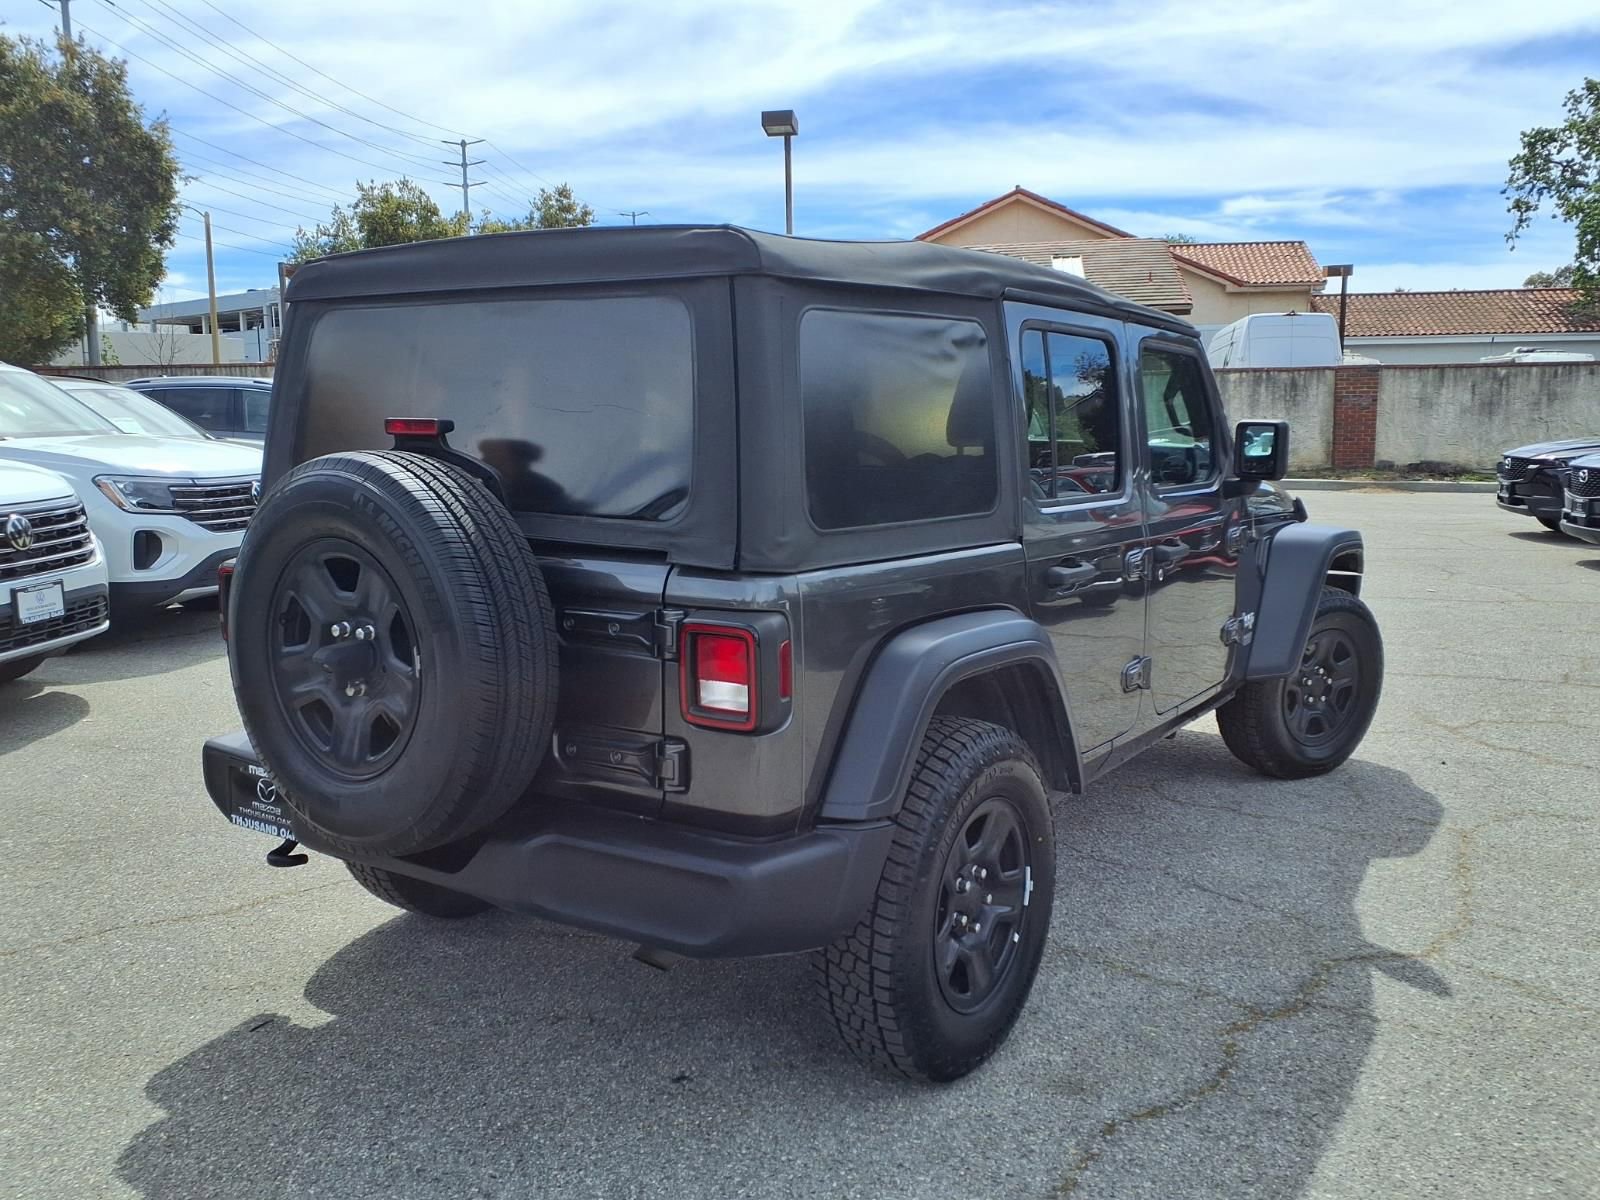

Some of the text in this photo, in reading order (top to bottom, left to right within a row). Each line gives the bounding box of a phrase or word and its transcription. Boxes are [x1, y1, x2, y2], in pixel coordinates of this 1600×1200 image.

[249, 765, 269, 778] maz
[239, 807, 291, 825] THOUSAND OAK
[231, 815, 296, 841] THOUSAND OA
